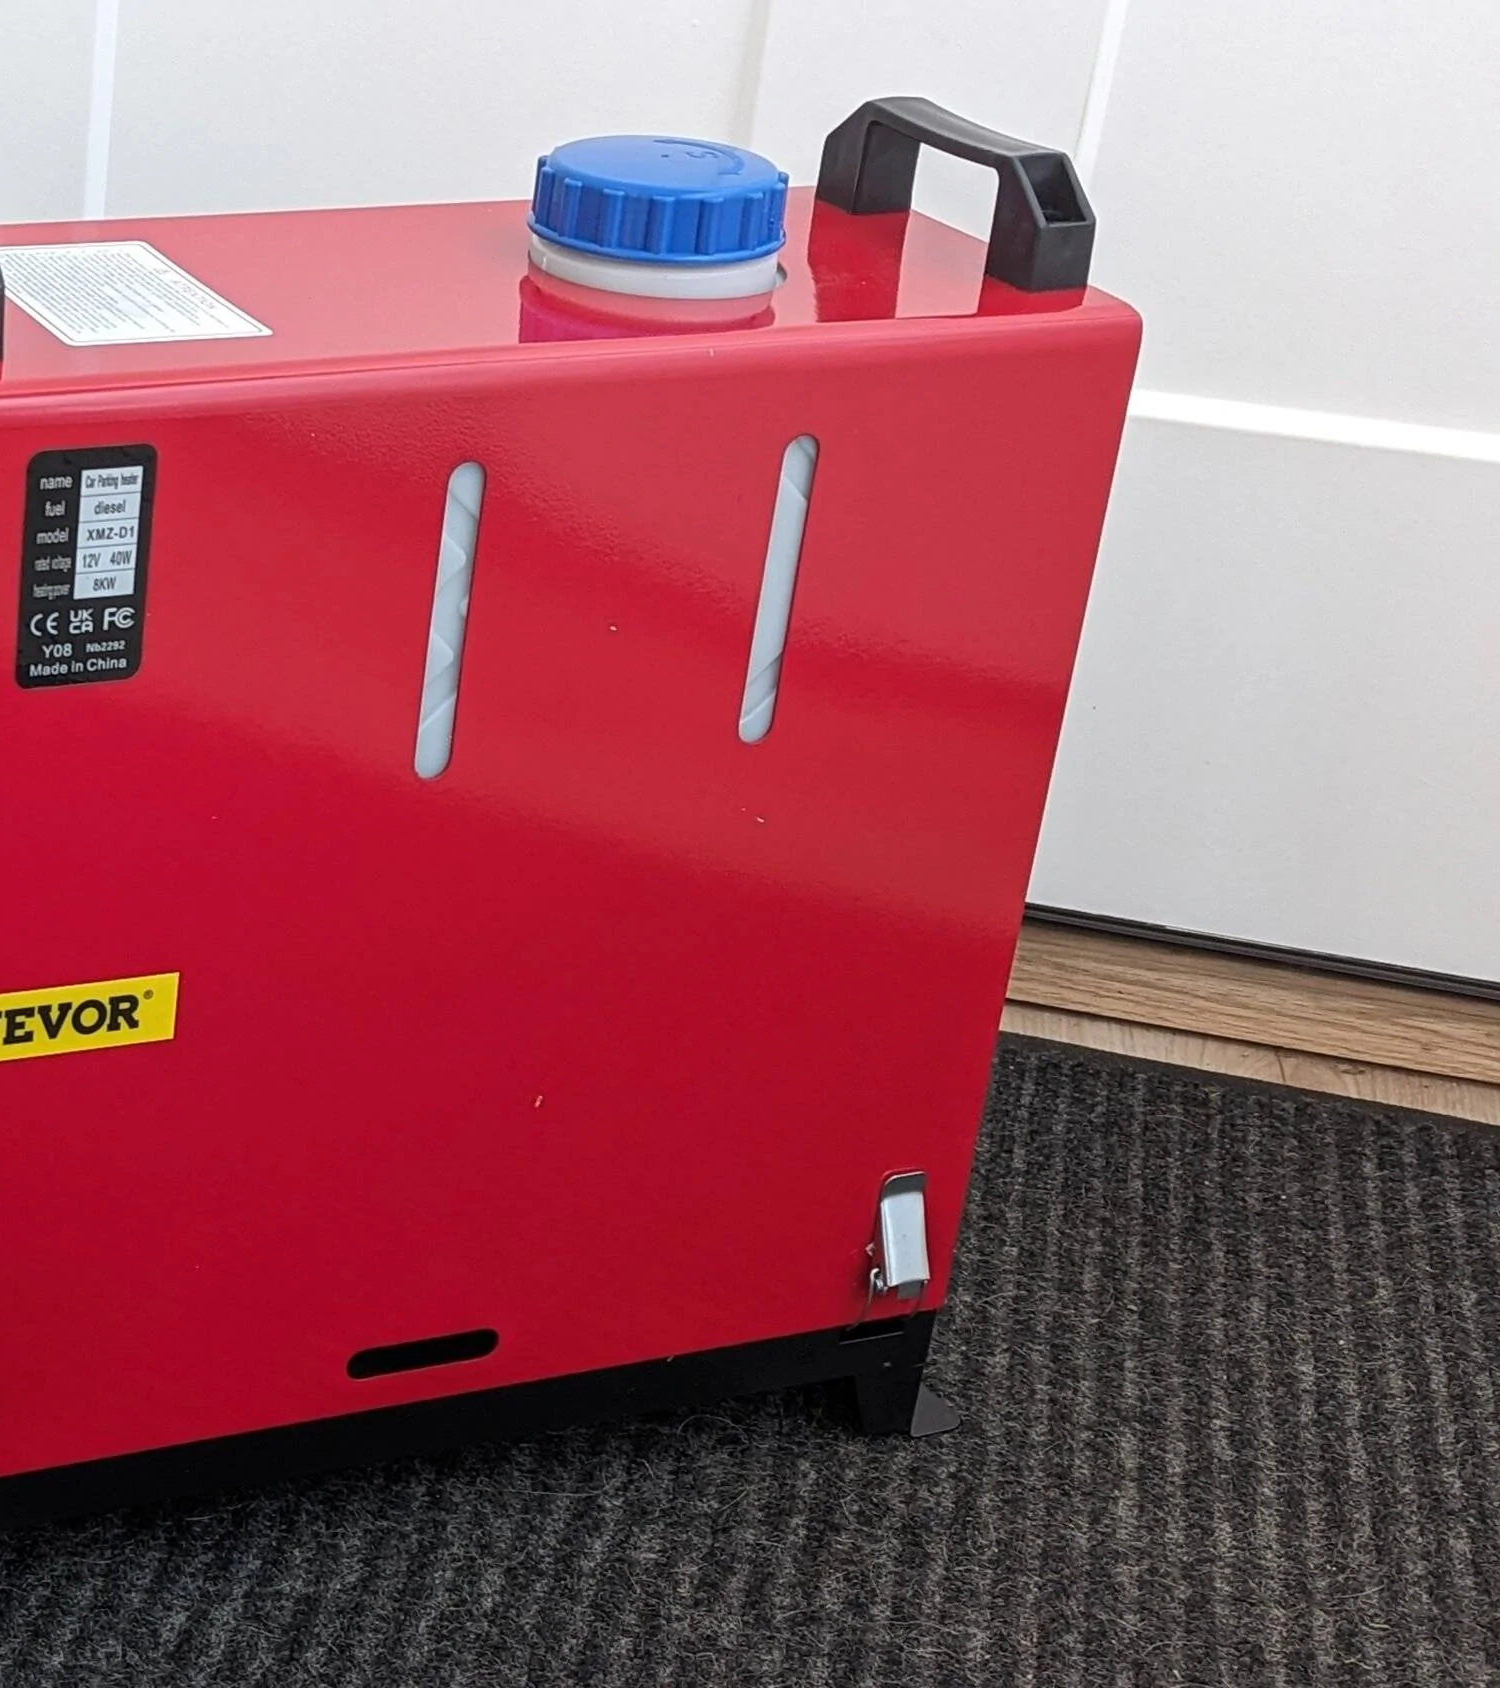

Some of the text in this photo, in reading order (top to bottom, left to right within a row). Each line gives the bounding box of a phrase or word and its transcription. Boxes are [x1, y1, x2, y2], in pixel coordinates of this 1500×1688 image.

[40, 476, 73, 490] name
[85, 475, 96, 489] Car
[44, 498, 126, 516] fuel diesel
[36, 526, 134, 544] model XMZ-D1
[82, 553, 101, 568] 12V
[110, 550, 132, 566] 40W
[93, 576, 116, 591] 8KW
[30, 612, 59, 636] CE
[69, 608, 94, 621] UK
[41, 640, 126, 658] Y08 Nb2292
[29, 657, 127, 677] Made in China
